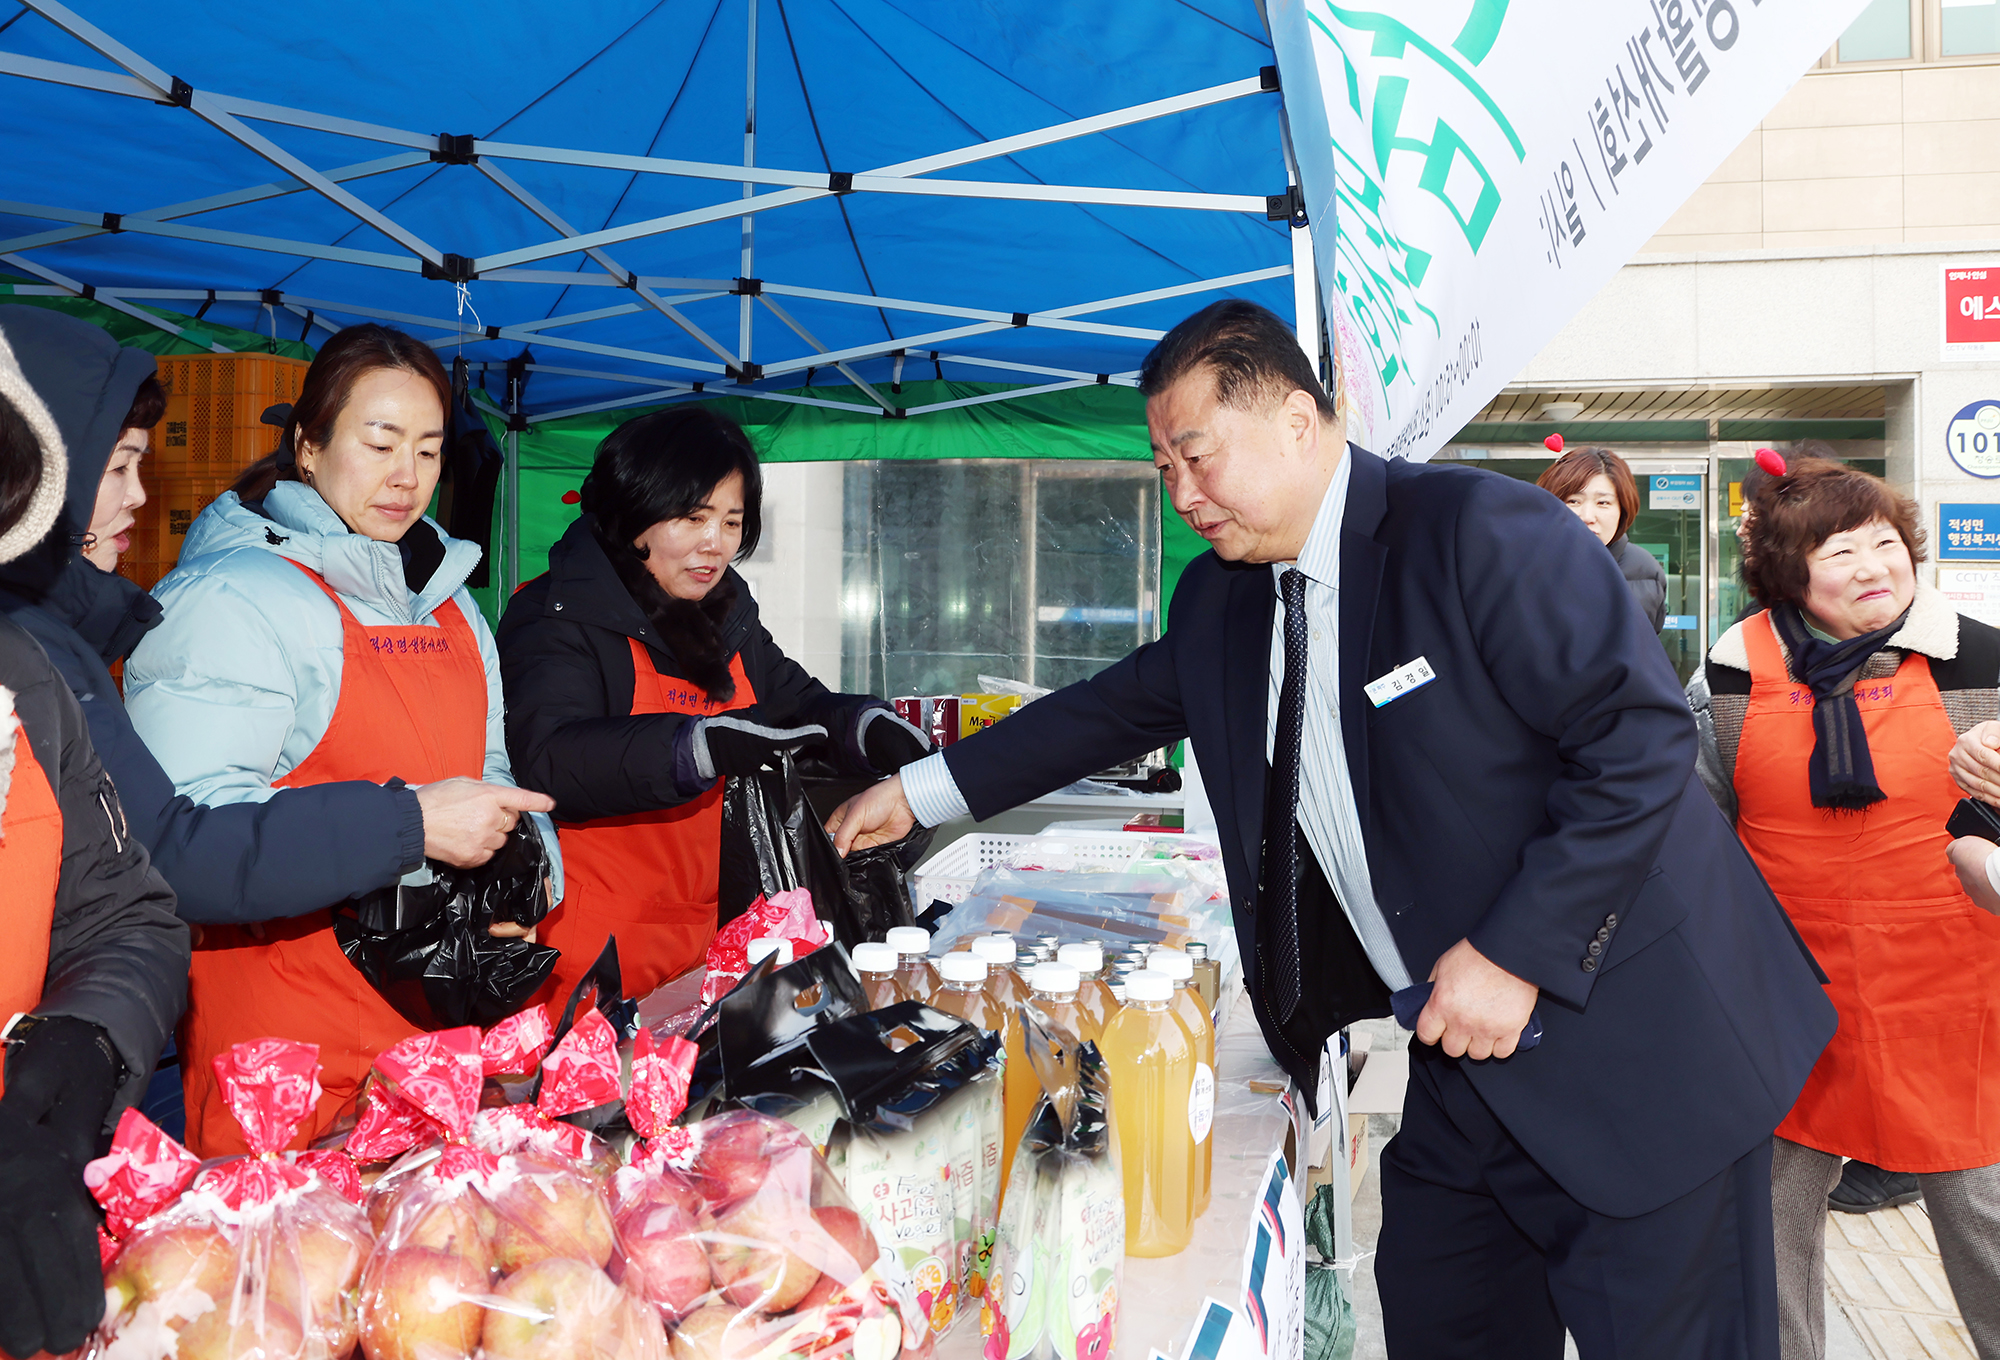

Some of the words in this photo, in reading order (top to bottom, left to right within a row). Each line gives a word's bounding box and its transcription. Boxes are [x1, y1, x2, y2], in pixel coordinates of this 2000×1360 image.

[1956, 432, 2000, 453] 101
[1948, 518, 1984, 532] 적성면
[1955, 572, 1989, 582] CCTV
